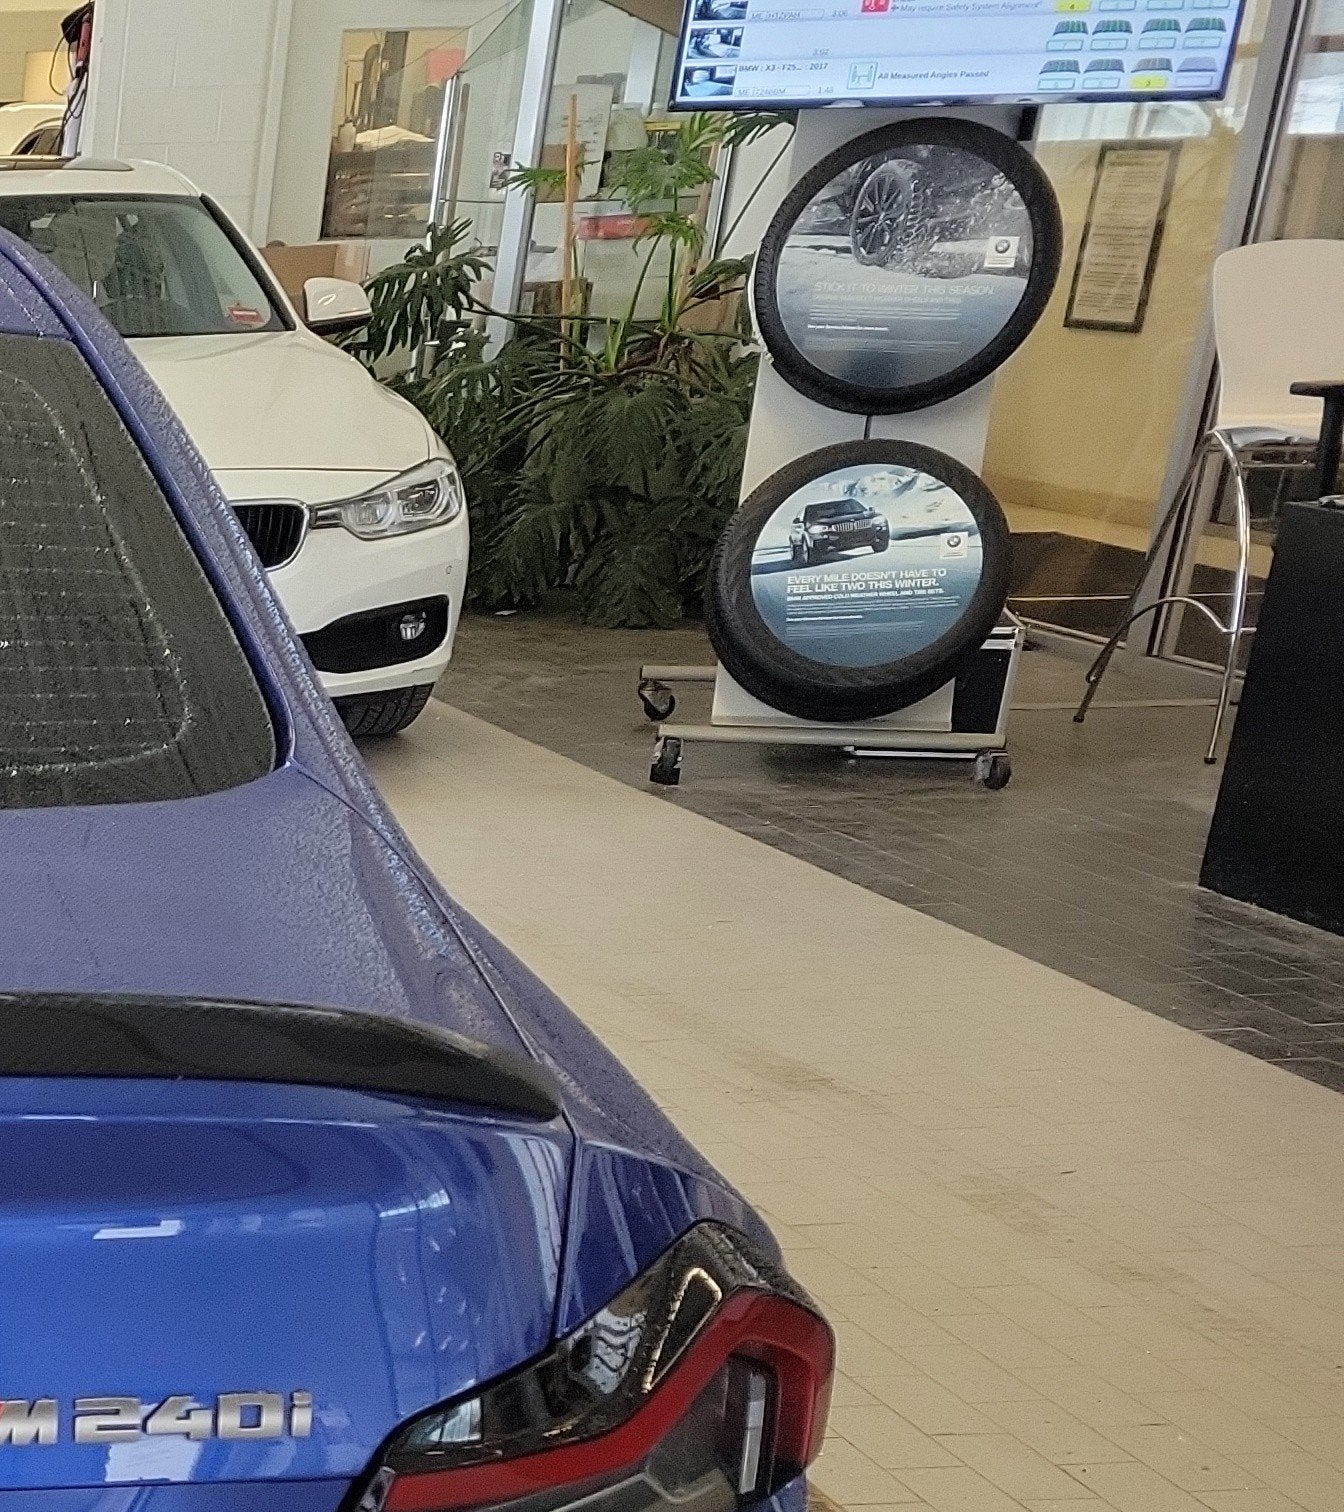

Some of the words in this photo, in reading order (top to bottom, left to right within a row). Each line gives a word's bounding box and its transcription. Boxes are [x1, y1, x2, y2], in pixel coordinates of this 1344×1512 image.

[739, 64, 759, 72] BMW
[809, 62, 829, 71] 2017
[890, 71, 929, 80] Measured
[930, 70, 958, 79] Angles
[960, 70, 990, 78] Passed
[814, 281, 845, 292] STICK
[861, 282, 876, 293] TO
[949, 285, 994, 295] SEASON
[787, 575, 822, 585] EVERY
[824, 573, 850, 583] MILE
[851, 571, 897, 581] DOESN'T
[900, 569, 930, 579] HAVE
[931, 568, 947, 577] TO
[787, 584, 813, 594] FEEL
[815, 582, 839, 592] LIKE
[841, 581, 866, 591] TWO
[867, 579, 893, 589] THIS
[894, 577, 940, 588] WINTER.
